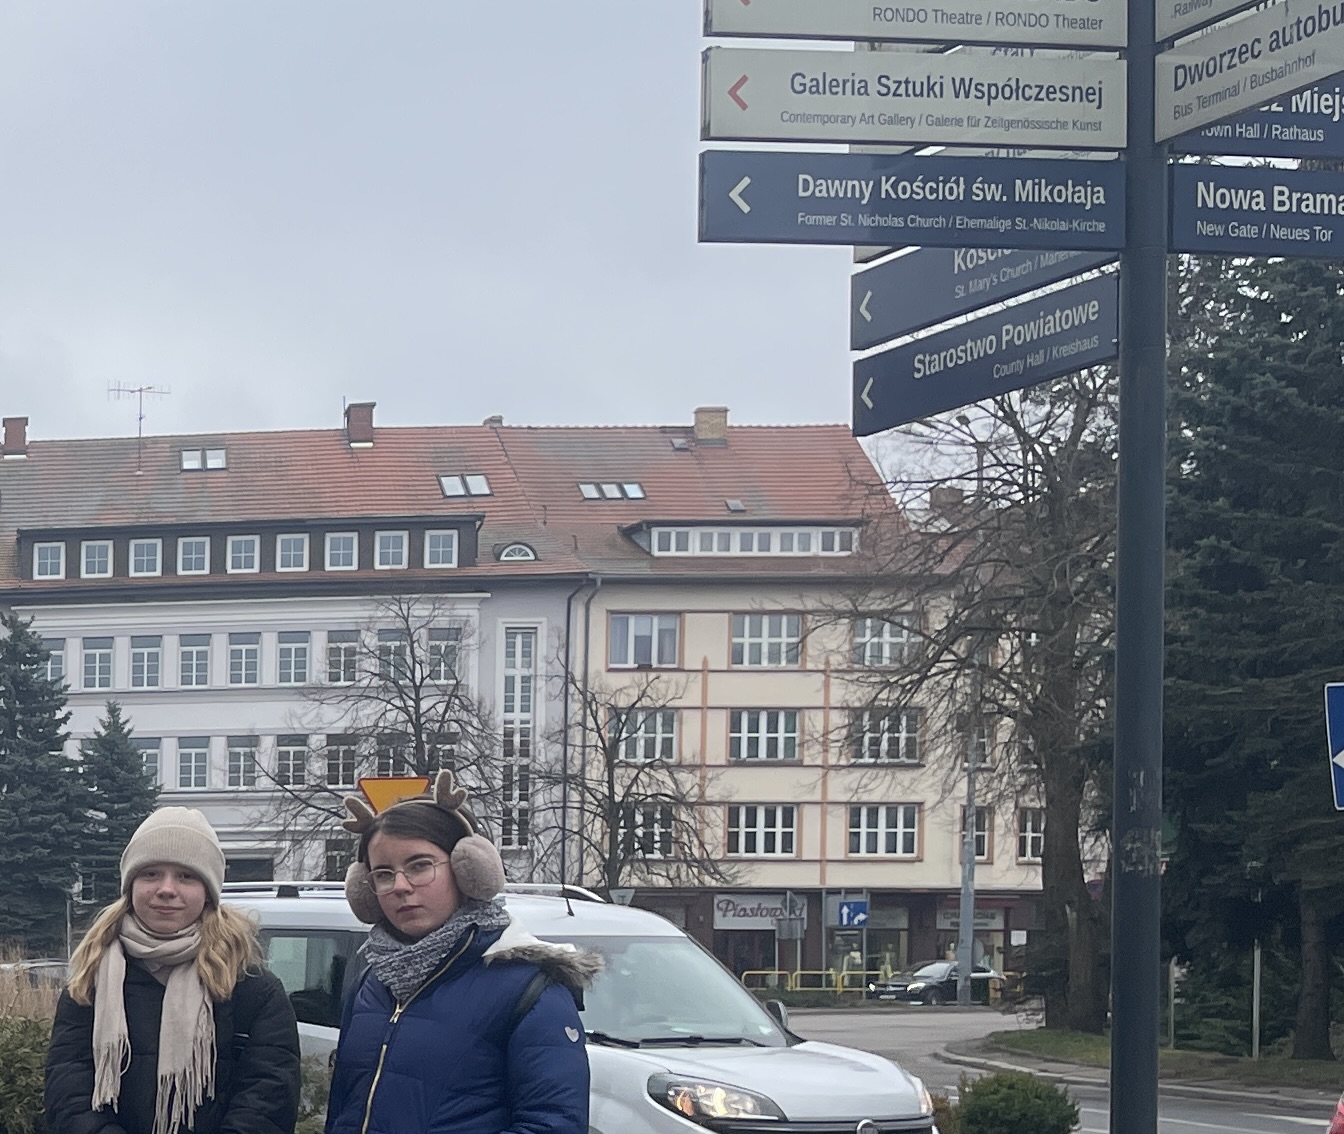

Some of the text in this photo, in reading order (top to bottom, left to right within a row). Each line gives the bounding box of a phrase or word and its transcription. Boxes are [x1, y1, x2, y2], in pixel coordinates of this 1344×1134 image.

[872, 7, 1103, 30] RONDO Theatre / RONDO Theater
[1173, 37, 1262, 92] Dworzec
[790, 71, 1103, 110] Galeria Sztuki Współczesnej
[1173, 102, 1194, 121] Bus
[1196, 80, 1240, 111] Terminal
[1250, 49, 1316, 90] Busbahnhof
[780, 111, 856, 127] Contemporary
[859, 112, 874, 125] Art
[878, 113, 916, 129] Gallery
[926, 114, 964, 127] Galerie
[967, 115, 981, 128] für
[984, 116, 1068, 131] Zeitgenössische
[1072, 119, 1102, 131] Kunst
[1235, 123, 1260, 139] Hall
[1264, 123, 1269, 139] /
[1272, 125, 1324, 142] Rathaus
[797, 173, 1106, 210] Dawny Kościół św. Mikołaja
[1197, 181, 1266, 211] Nowa
[797, 212, 837, 226] Former
[840, 213, 855, 226] St.
[858, 214, 904, 227] Nicholas
[907, 215, 946, 229] Church
[955, 216, 1012, 233] Ehemalige
[1197, 220, 1334, 242] New Gate / Neues Tor
[969, 273, 998, 293] Mary's
[999, 258, 1032, 283] Church
[913, 300, 1099, 379] Starostwo Powiatowe
[993, 356, 1024, 378] County
[1026, 349, 1045, 368] Hall
[1052, 335, 1099, 360] Kreishaus
